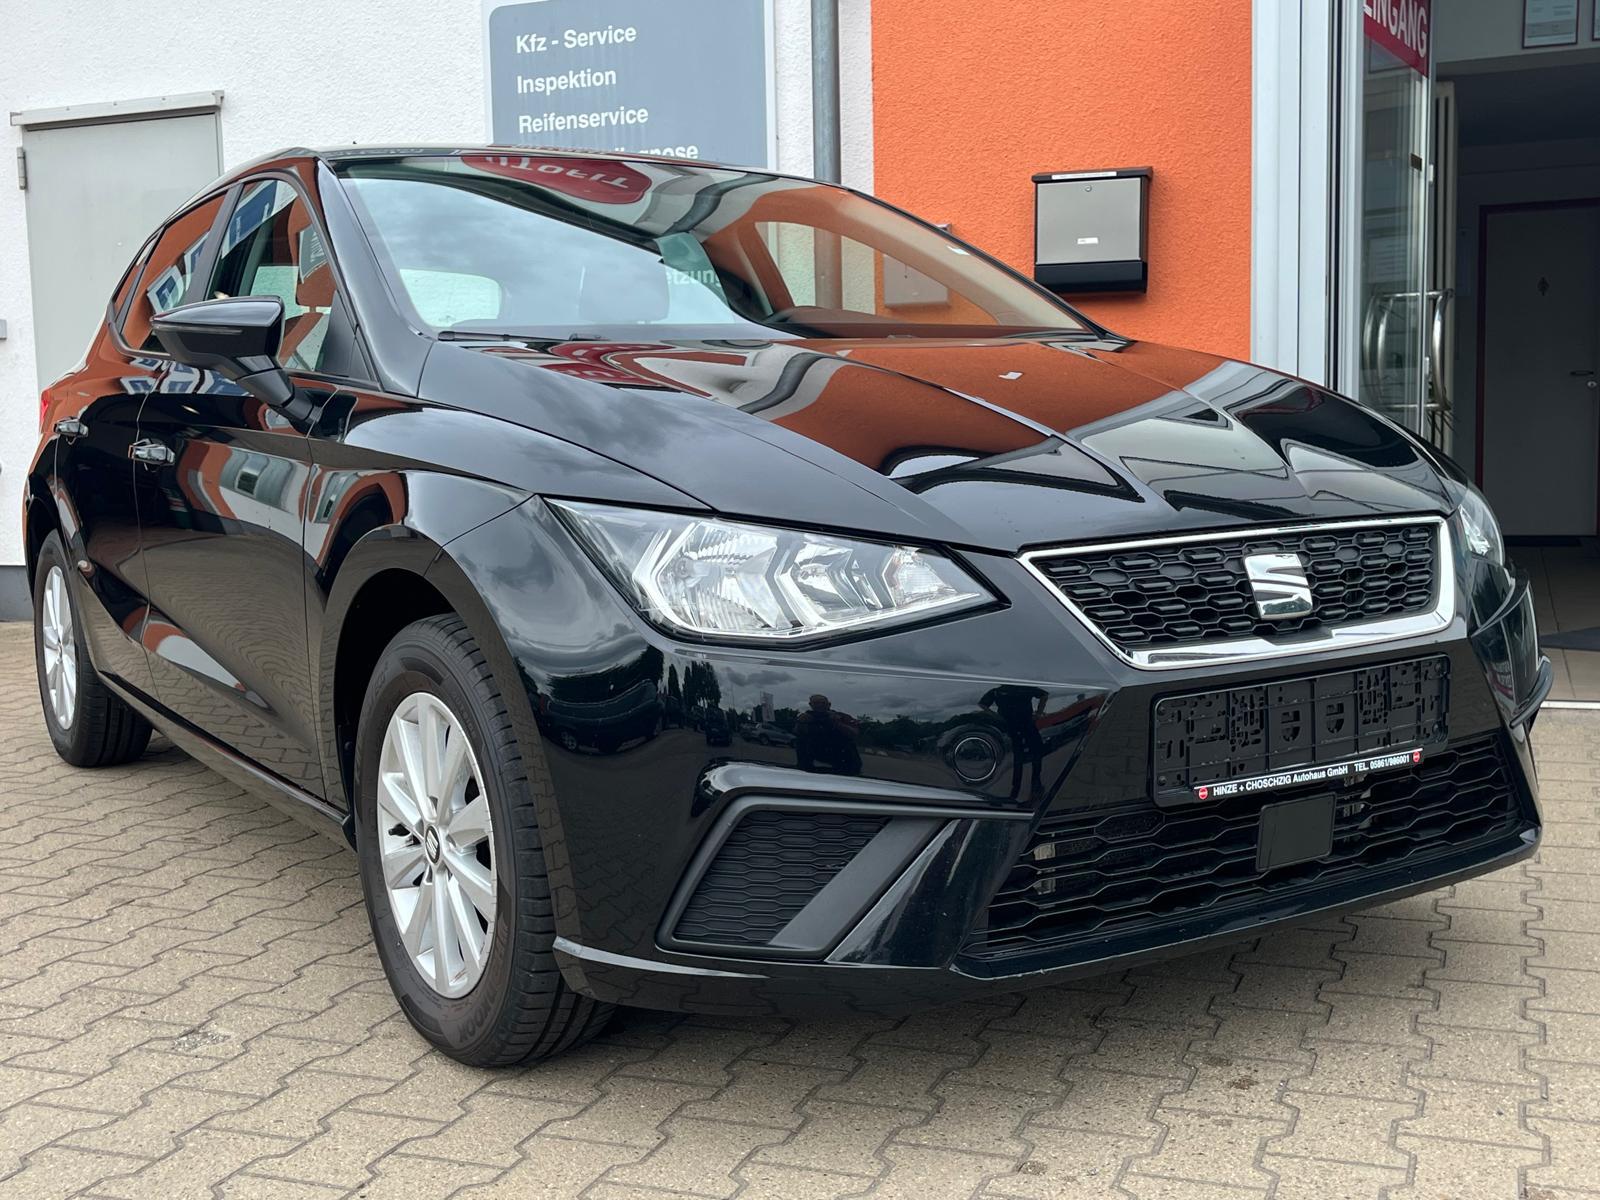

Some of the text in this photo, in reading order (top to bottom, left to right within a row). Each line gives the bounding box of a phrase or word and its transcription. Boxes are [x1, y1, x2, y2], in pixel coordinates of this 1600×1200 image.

[516, 33, 547, 54] Kfz
[564, 25, 637, 49] Service
[517, 69, 617, 95] Inspektion
[519, 106, 649, 134] Reifenservice
[1213, 784, 1238, 796] HINZE
[1246, 775, 1291, 791] CHOSCHZIG
[1293, 770, 1326, 783] Autohaus
[1327, 766, 1348, 777] GmbH
[1355, 762, 1369, 772] TEL.
